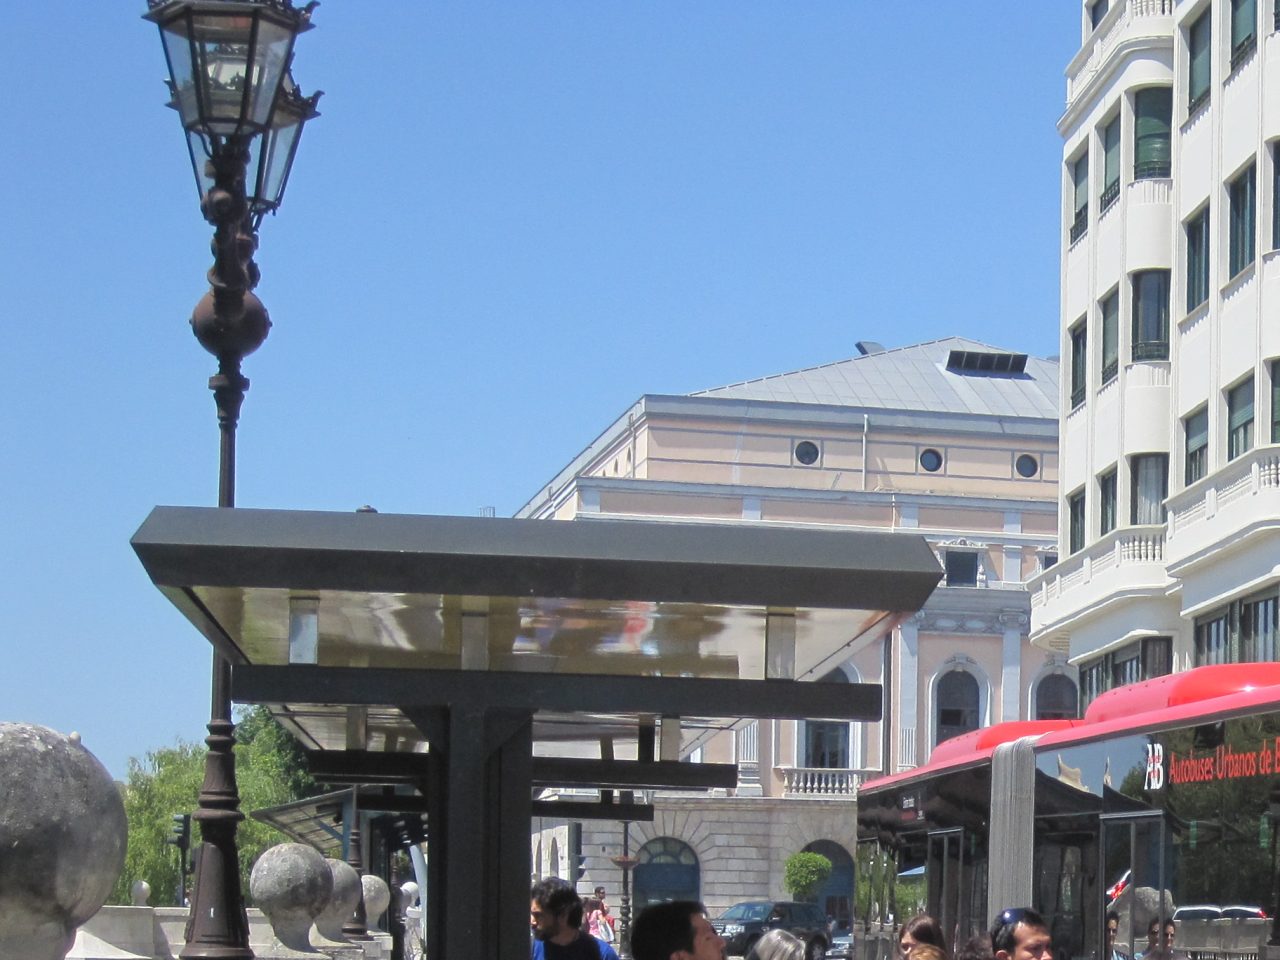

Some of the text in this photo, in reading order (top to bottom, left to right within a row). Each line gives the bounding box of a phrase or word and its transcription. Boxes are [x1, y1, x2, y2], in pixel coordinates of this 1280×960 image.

[1169, 750, 1213, 784] Autobuses
[1216, 744, 1256, 780] Urbanos
[1259, 739, 1271, 774] de
